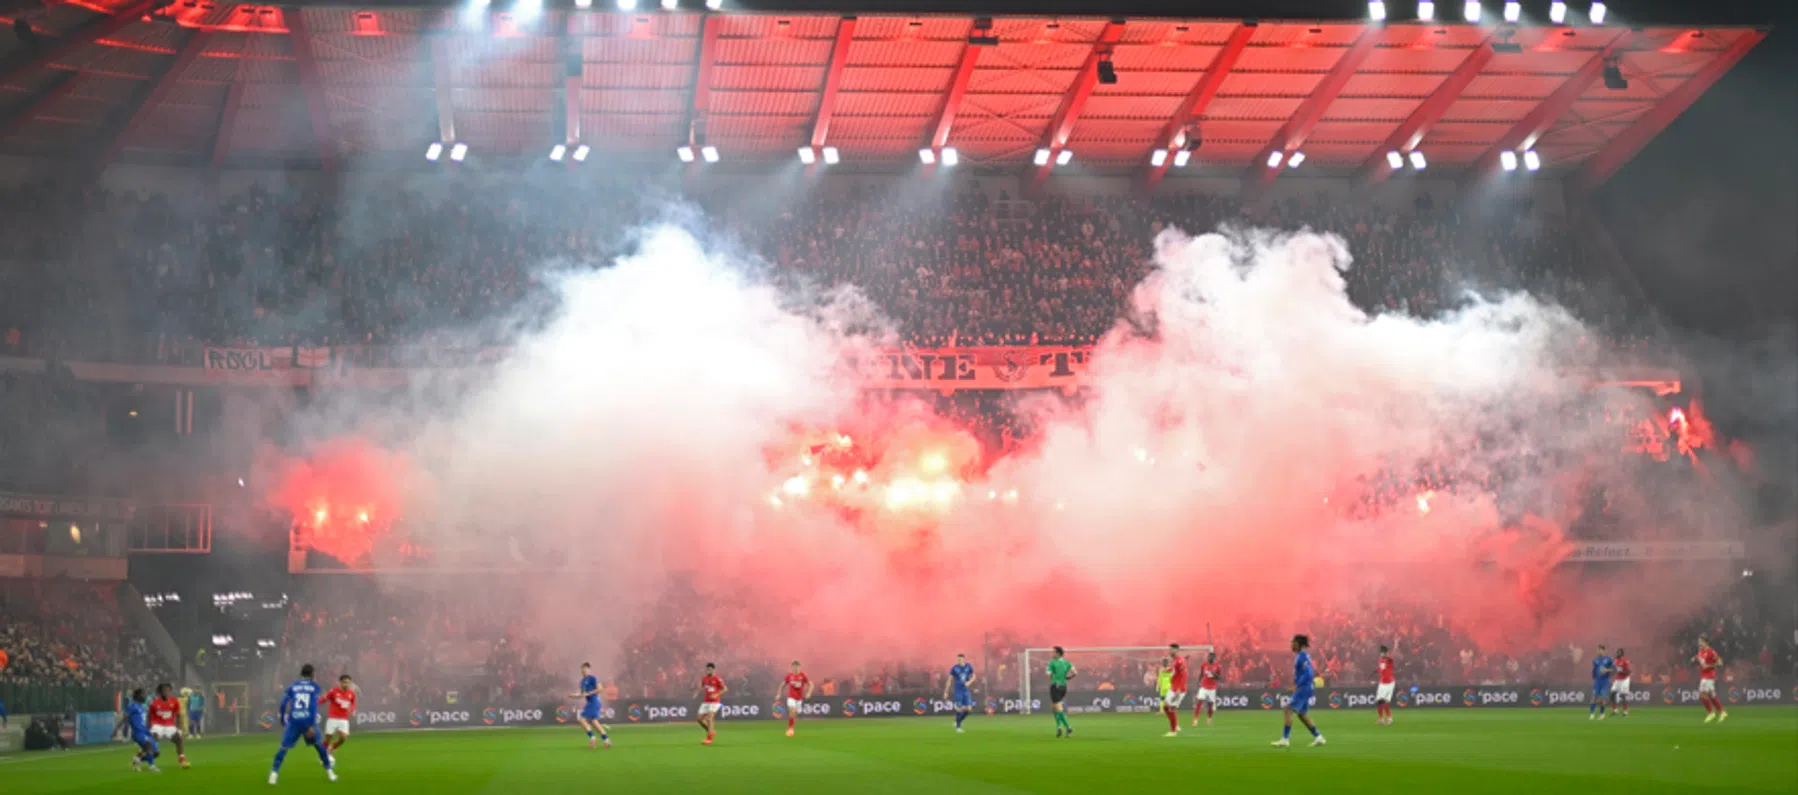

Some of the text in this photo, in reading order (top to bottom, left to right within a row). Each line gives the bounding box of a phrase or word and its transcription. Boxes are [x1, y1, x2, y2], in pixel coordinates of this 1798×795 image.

[886, 352, 1086, 381] NE T
[356, 711, 396, 725] pace
